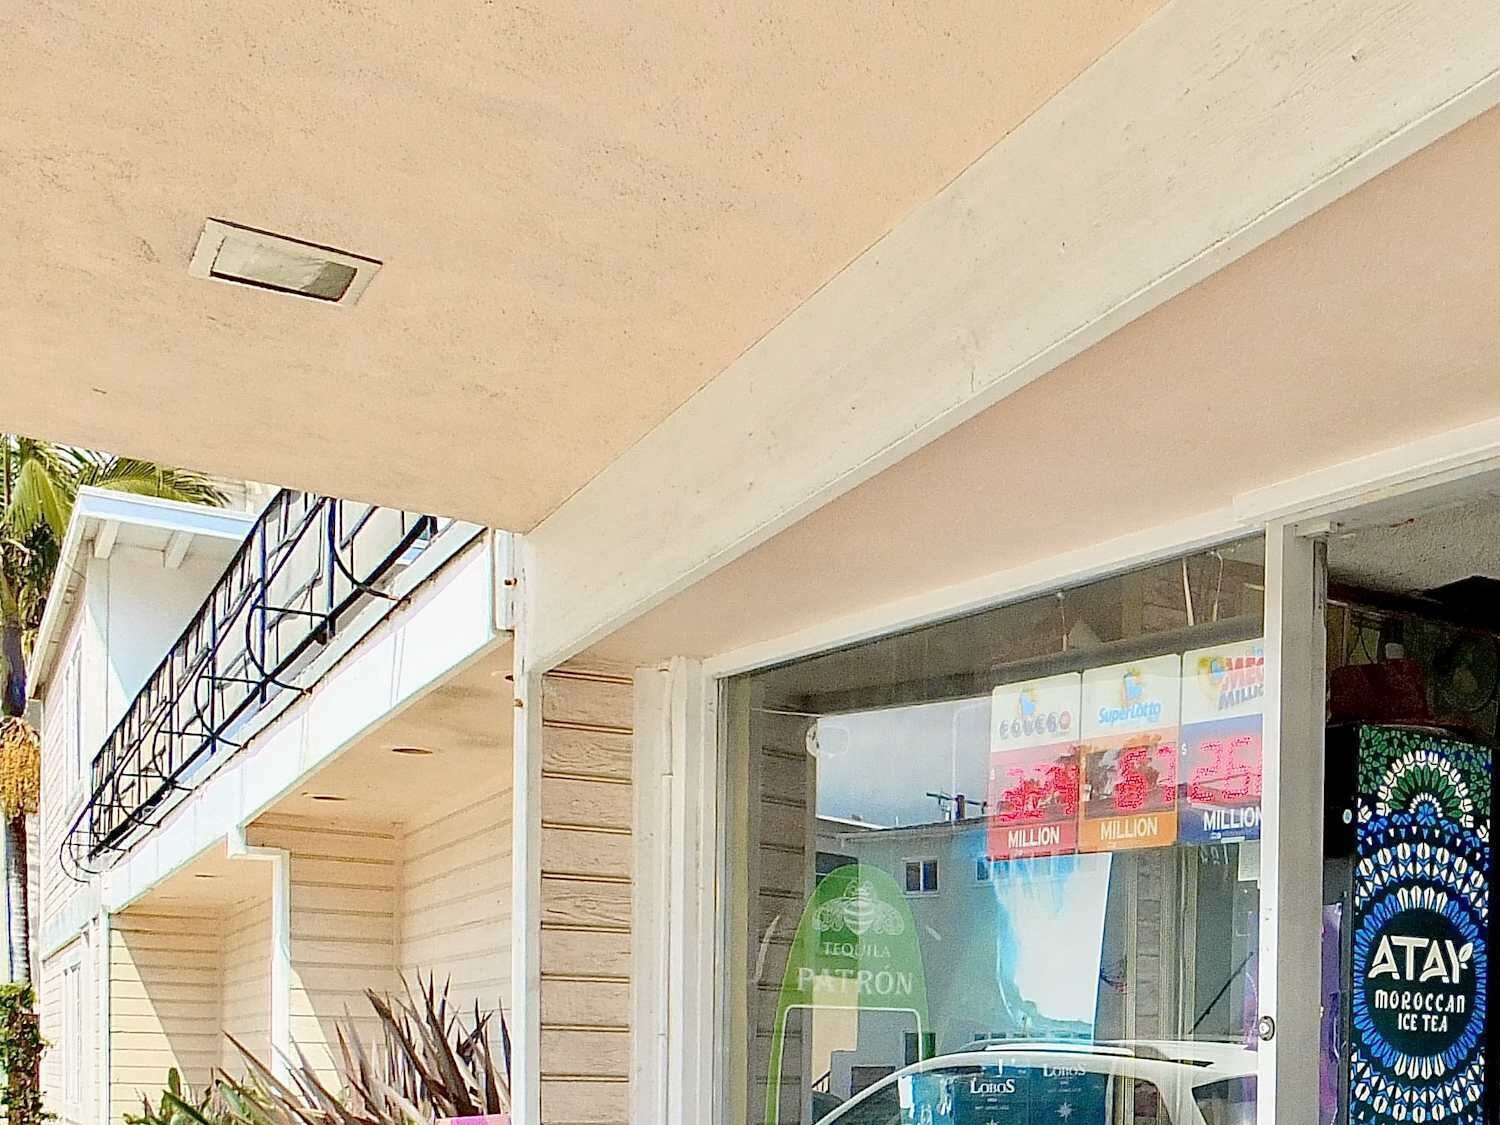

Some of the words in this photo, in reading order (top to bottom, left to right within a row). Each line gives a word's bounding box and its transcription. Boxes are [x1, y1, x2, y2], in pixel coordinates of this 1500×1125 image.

[1008, 826, 1060, 848] MILLION
[1101, 817, 1158, 840] MILLION
[823, 942, 891, 959] TEQUILA
[1368, 935, 1473, 984] ATAY
[1375, 990, 1465, 1013] MOROCCAN
[1398, 1013, 1417, 1031] ICE
[1422, 1014, 1448, 1032] TEA
